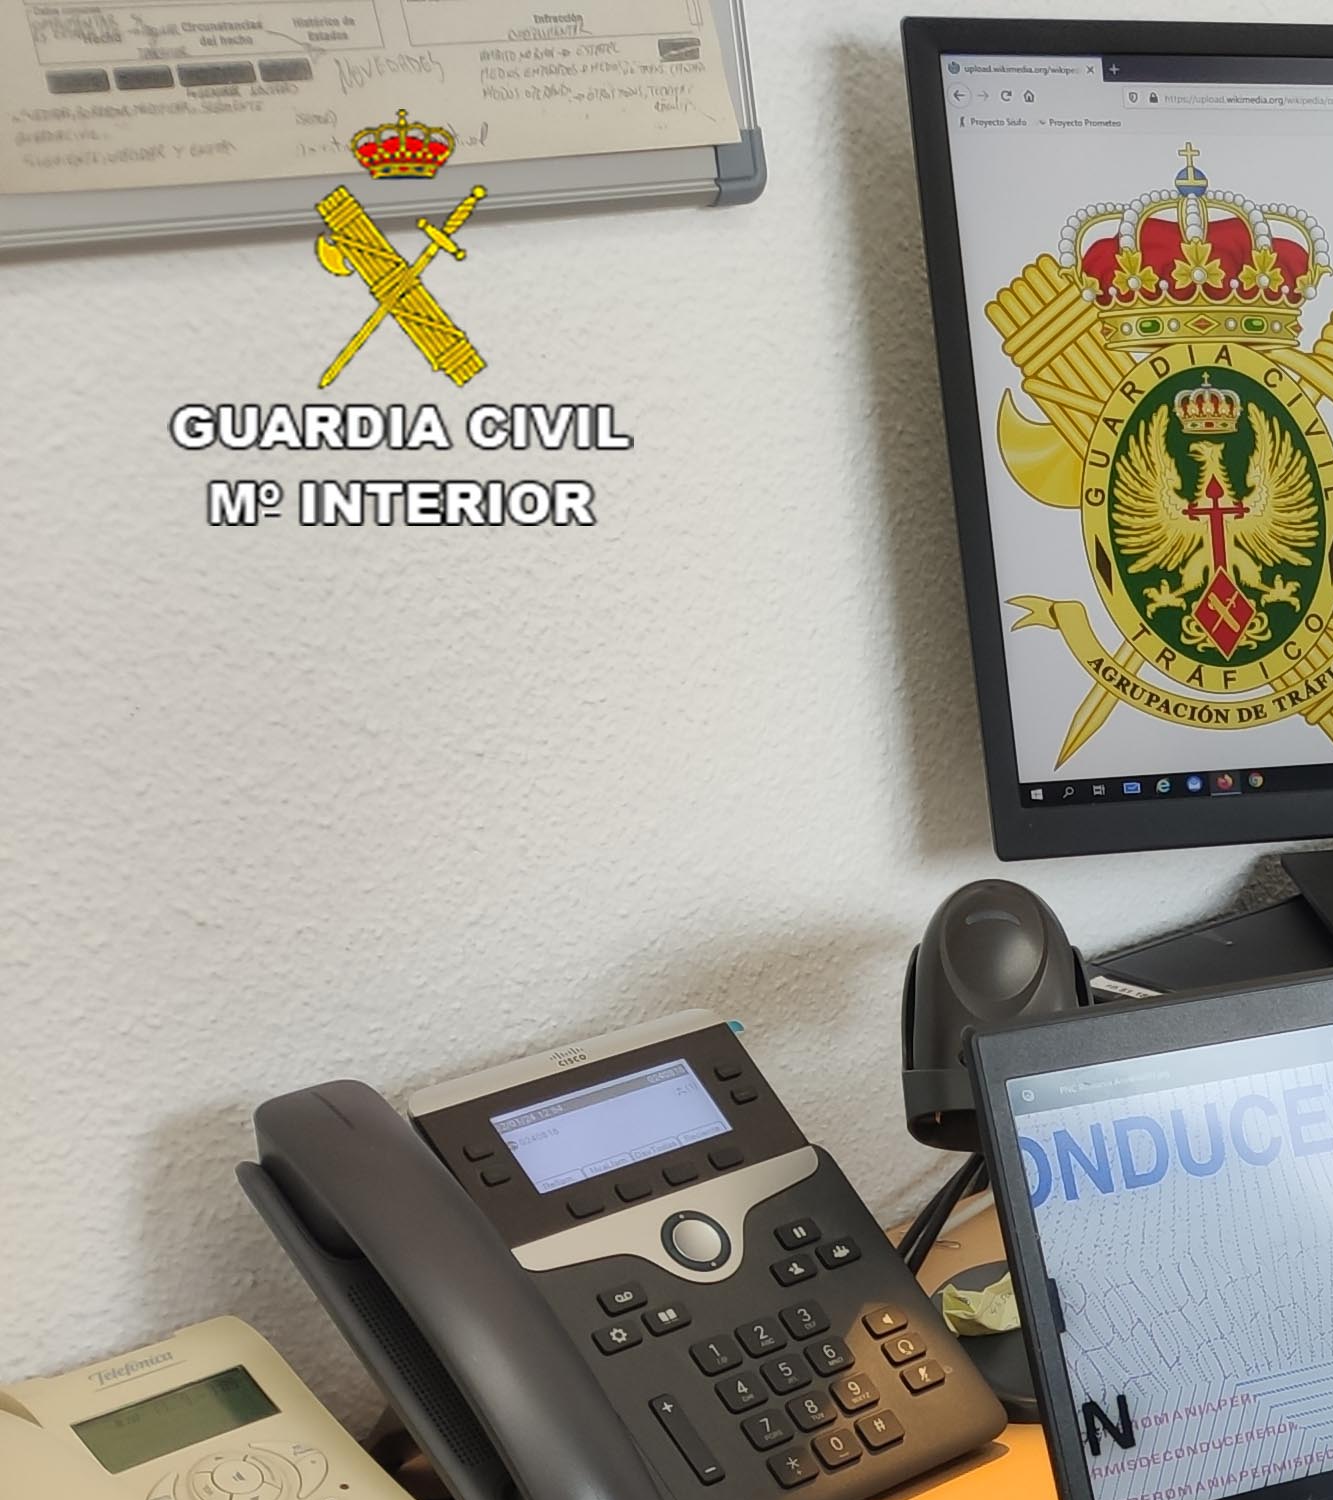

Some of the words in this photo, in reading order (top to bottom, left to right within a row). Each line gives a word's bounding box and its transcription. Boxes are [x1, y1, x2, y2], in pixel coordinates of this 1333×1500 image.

[970, 117, 1006, 128] Proyecto
[1049, 119, 1083, 129] Proyecto
[1084, 119, 1121, 128] Prometeo
[1085, 345, 1233, 508] GUARDIA
[1087, 656, 1230, 725] AGRUPACIÓN
[1238, 704, 1268, 724] DE
[557, 1053, 587, 1067] CISCO
[797, 1308, 811, 1322] 3
[753, 1325, 768, 1340] 2
[708, 1343, 721, 1357] 1
[822, 1344, 836, 1358] 6
[778, 1362, 793, 1377] 5
[737, 1380, 748, 1394] 4
[847, 1381, 861, 1395] 9
[804, 1399, 818, 1414] 8
[760, 1418, 771, 1432] 7
[1082, 1394, 1136, 1457] N
[830, 1436, 843, 1451] 0
